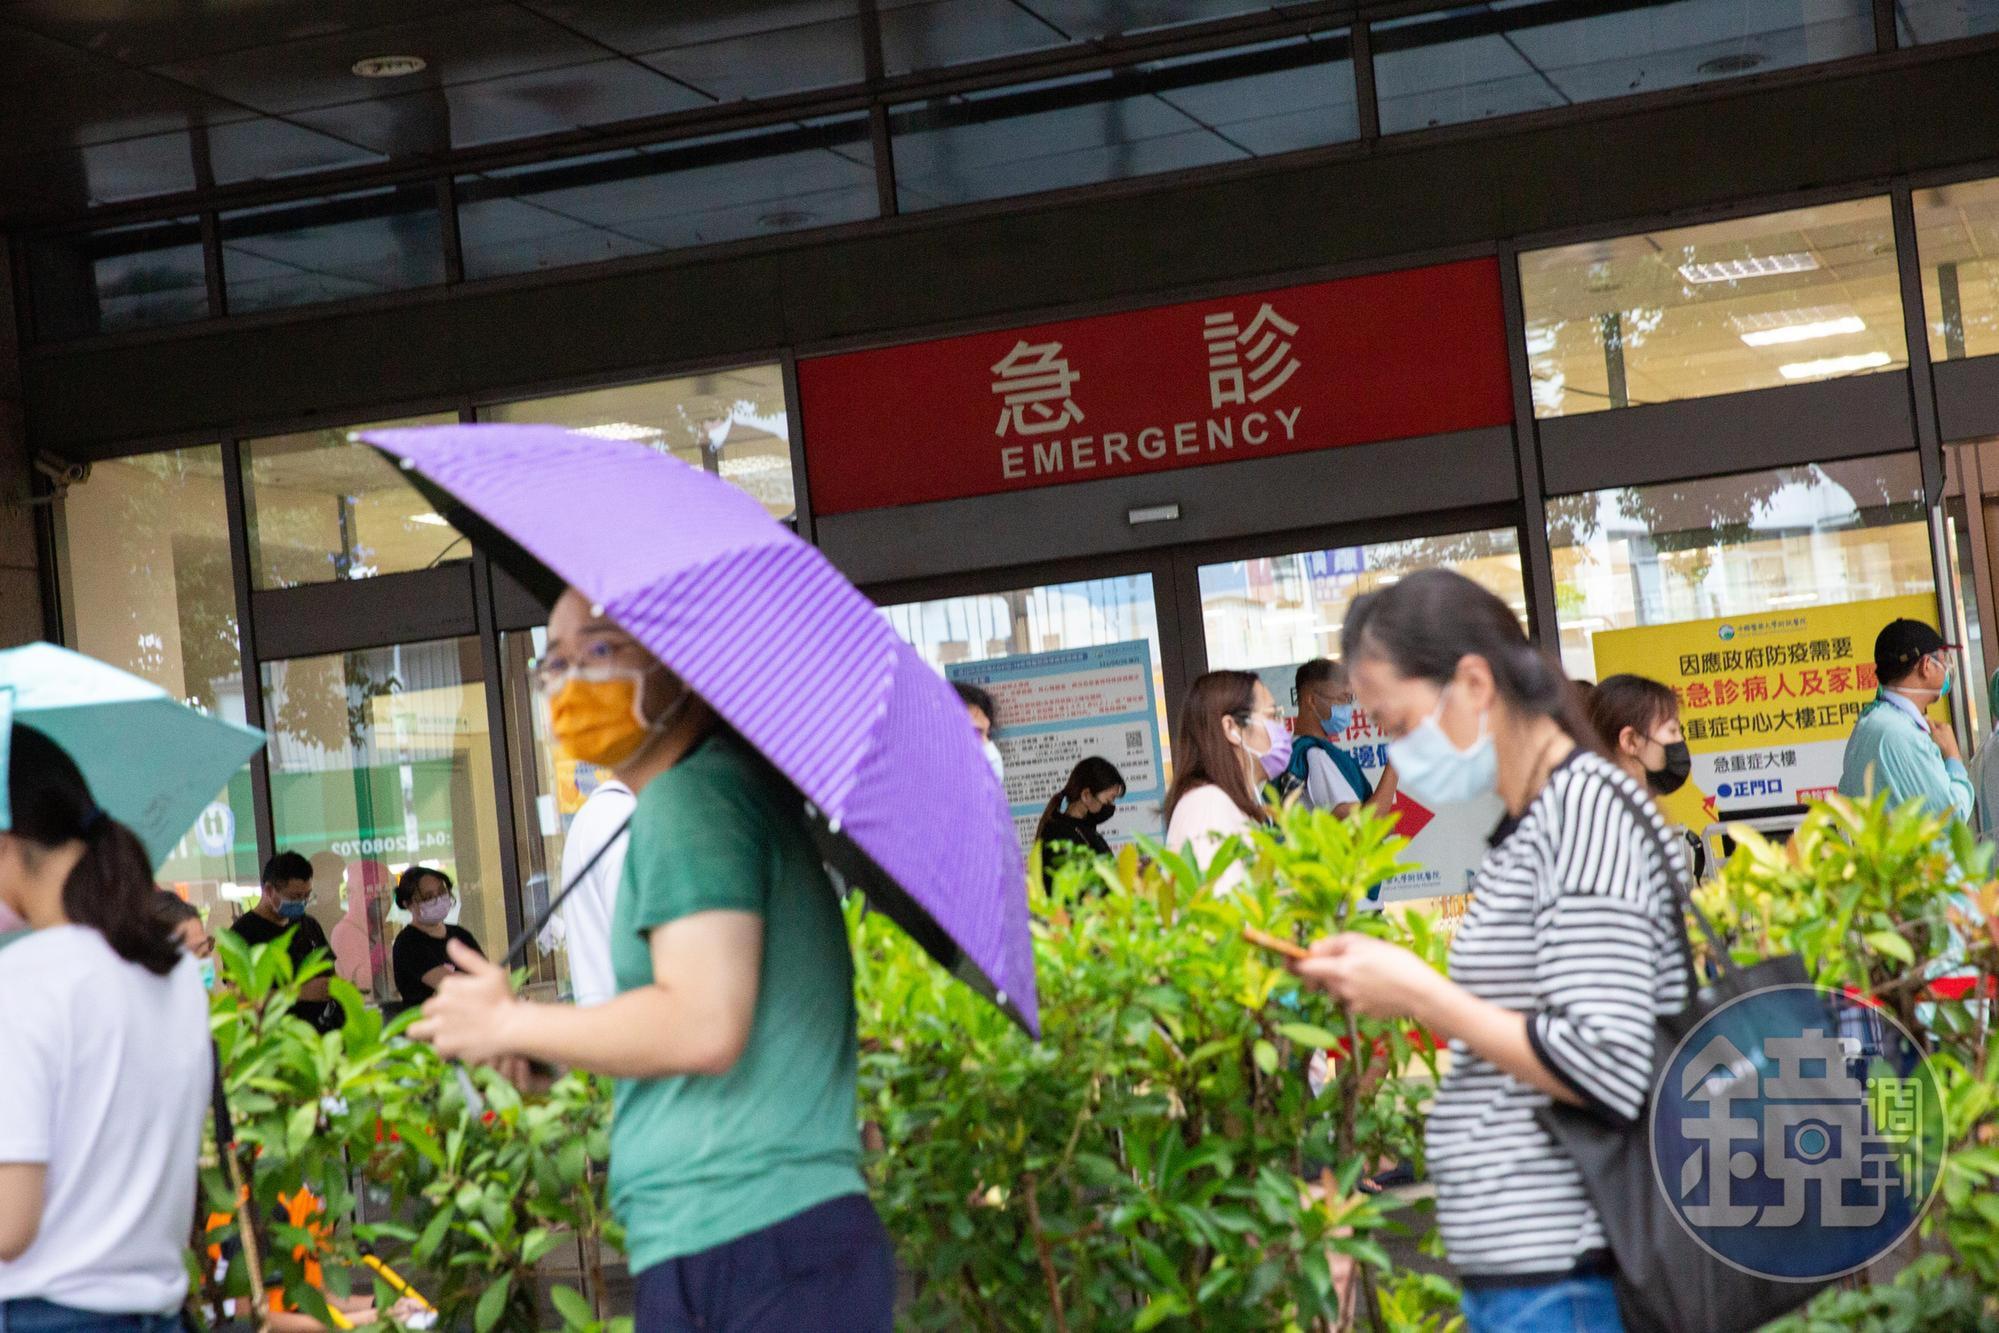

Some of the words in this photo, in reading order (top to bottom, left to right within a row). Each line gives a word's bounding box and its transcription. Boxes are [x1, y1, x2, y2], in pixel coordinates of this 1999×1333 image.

[991, 303, 1301, 437] 急診
[1002, 406, 1301, 479] EMERGENCY
[1680, 636, 1853, 676] 因應政府防疫需要
[1671, 662, 1878, 709] 急診病人及家屬
[1681, 701, 1879, 740] 重症中心大樓正門
[1714, 750, 1797, 774] 急重症大樓
[1734, 778, 1783, 797] 正門口
